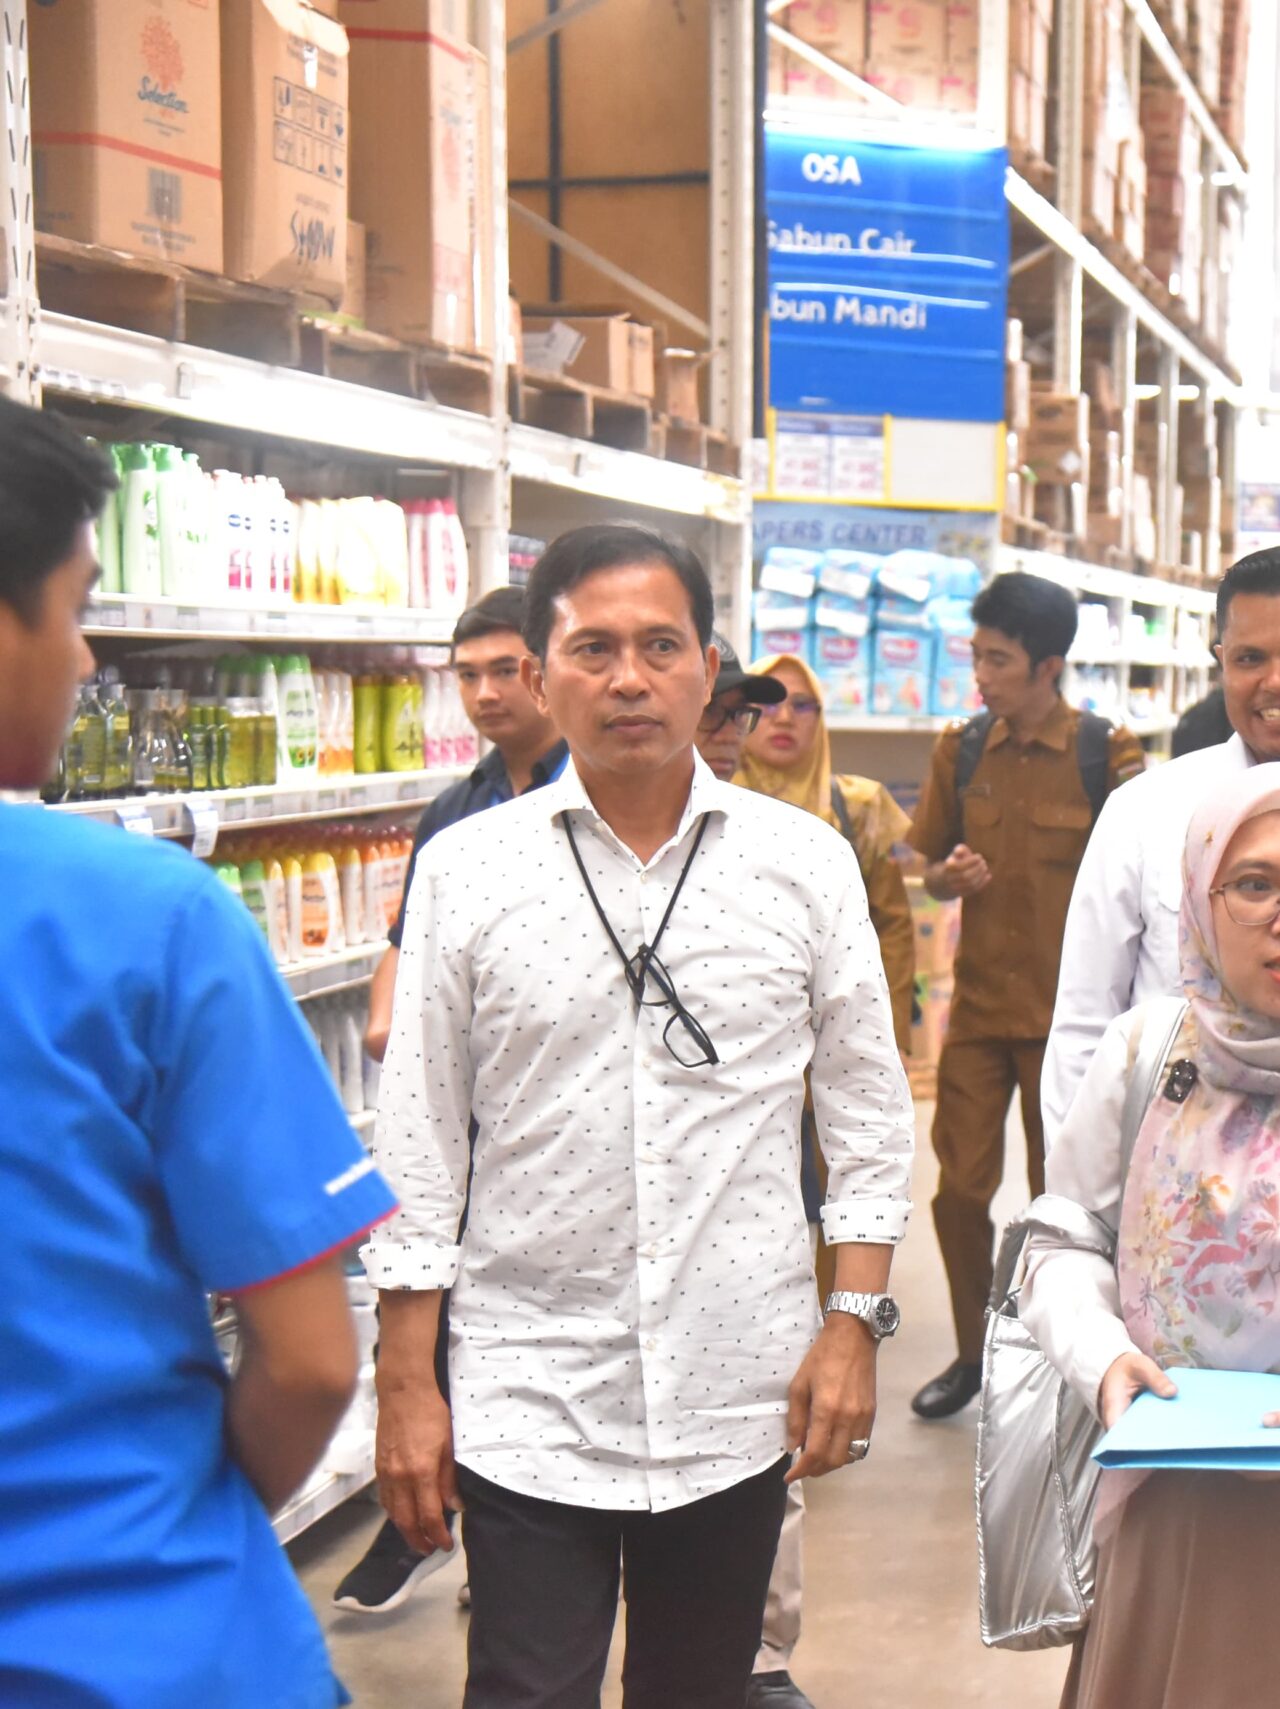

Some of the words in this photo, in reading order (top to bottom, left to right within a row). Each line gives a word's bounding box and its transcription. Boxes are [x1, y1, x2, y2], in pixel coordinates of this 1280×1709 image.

[802, 153, 862, 186] OSA
[859, 228, 916, 254] Cair
[834, 295, 927, 330] Mandi
[831, 522, 927, 546] CENTER
